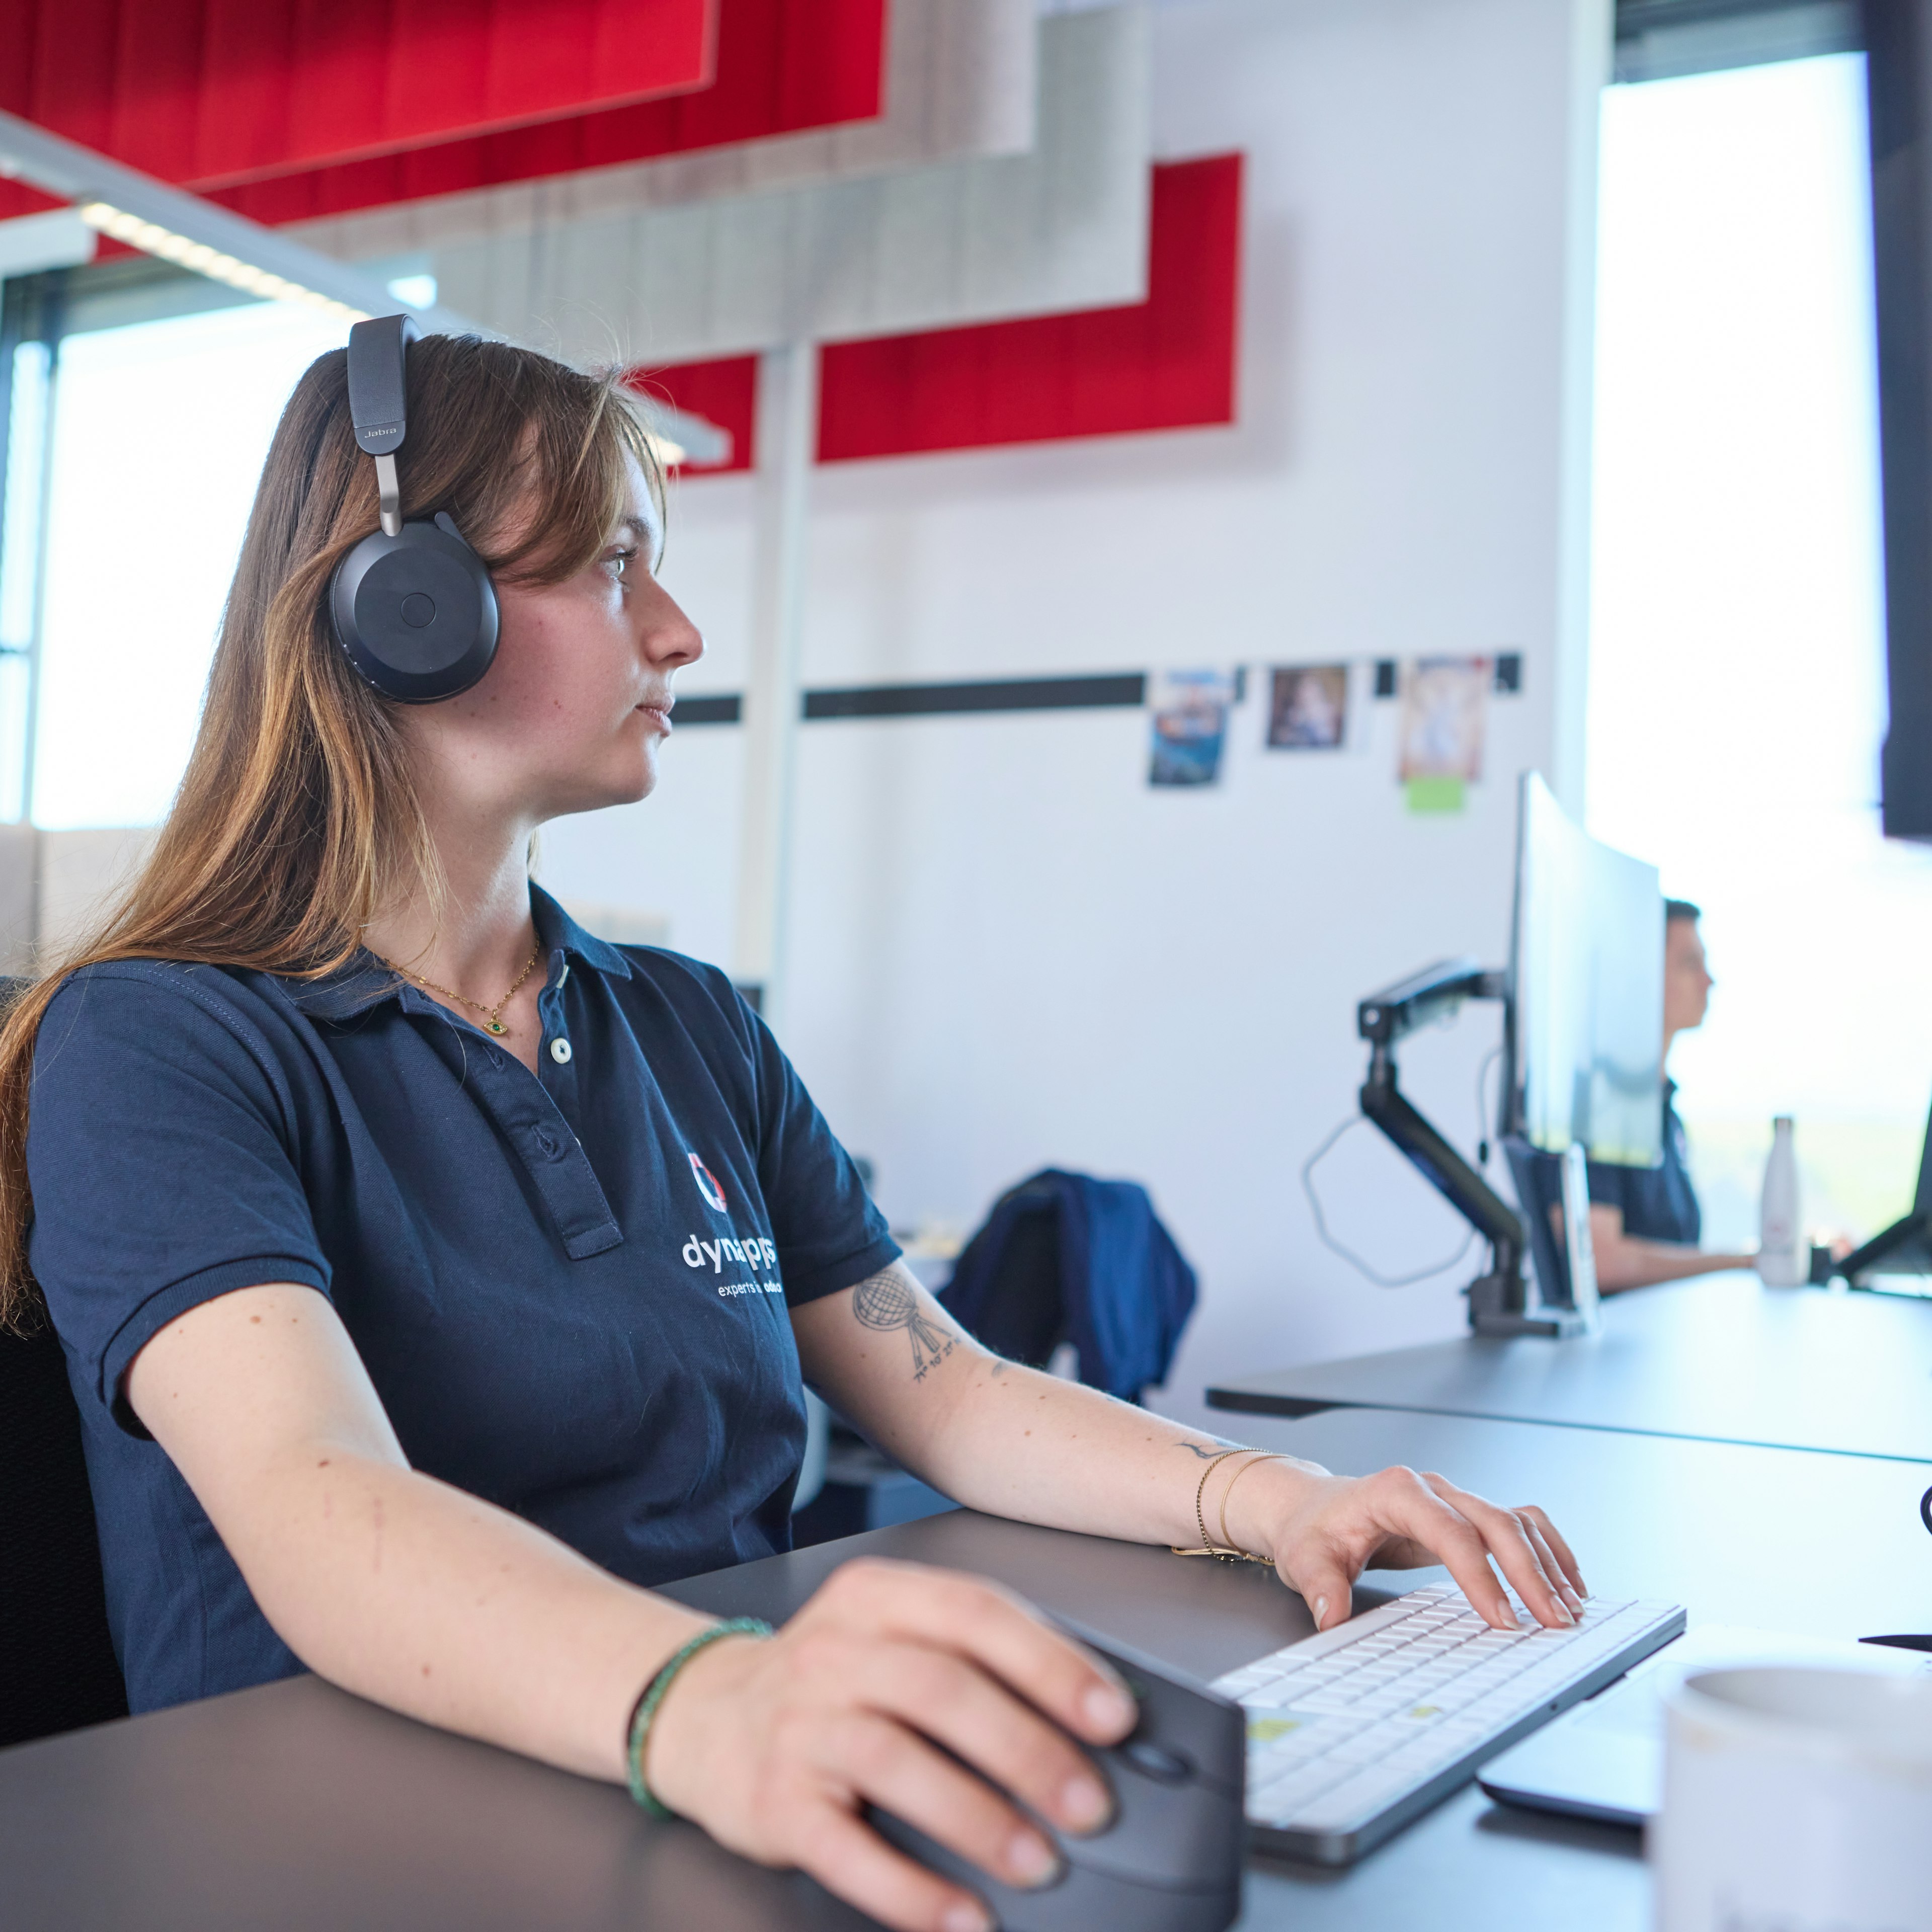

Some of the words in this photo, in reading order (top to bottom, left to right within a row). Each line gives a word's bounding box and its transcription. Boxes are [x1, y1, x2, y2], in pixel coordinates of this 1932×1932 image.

[364, 428, 396, 438] Jabra
[718, 1282, 756, 1298] experts
[753, 1280, 763, 1294] in
